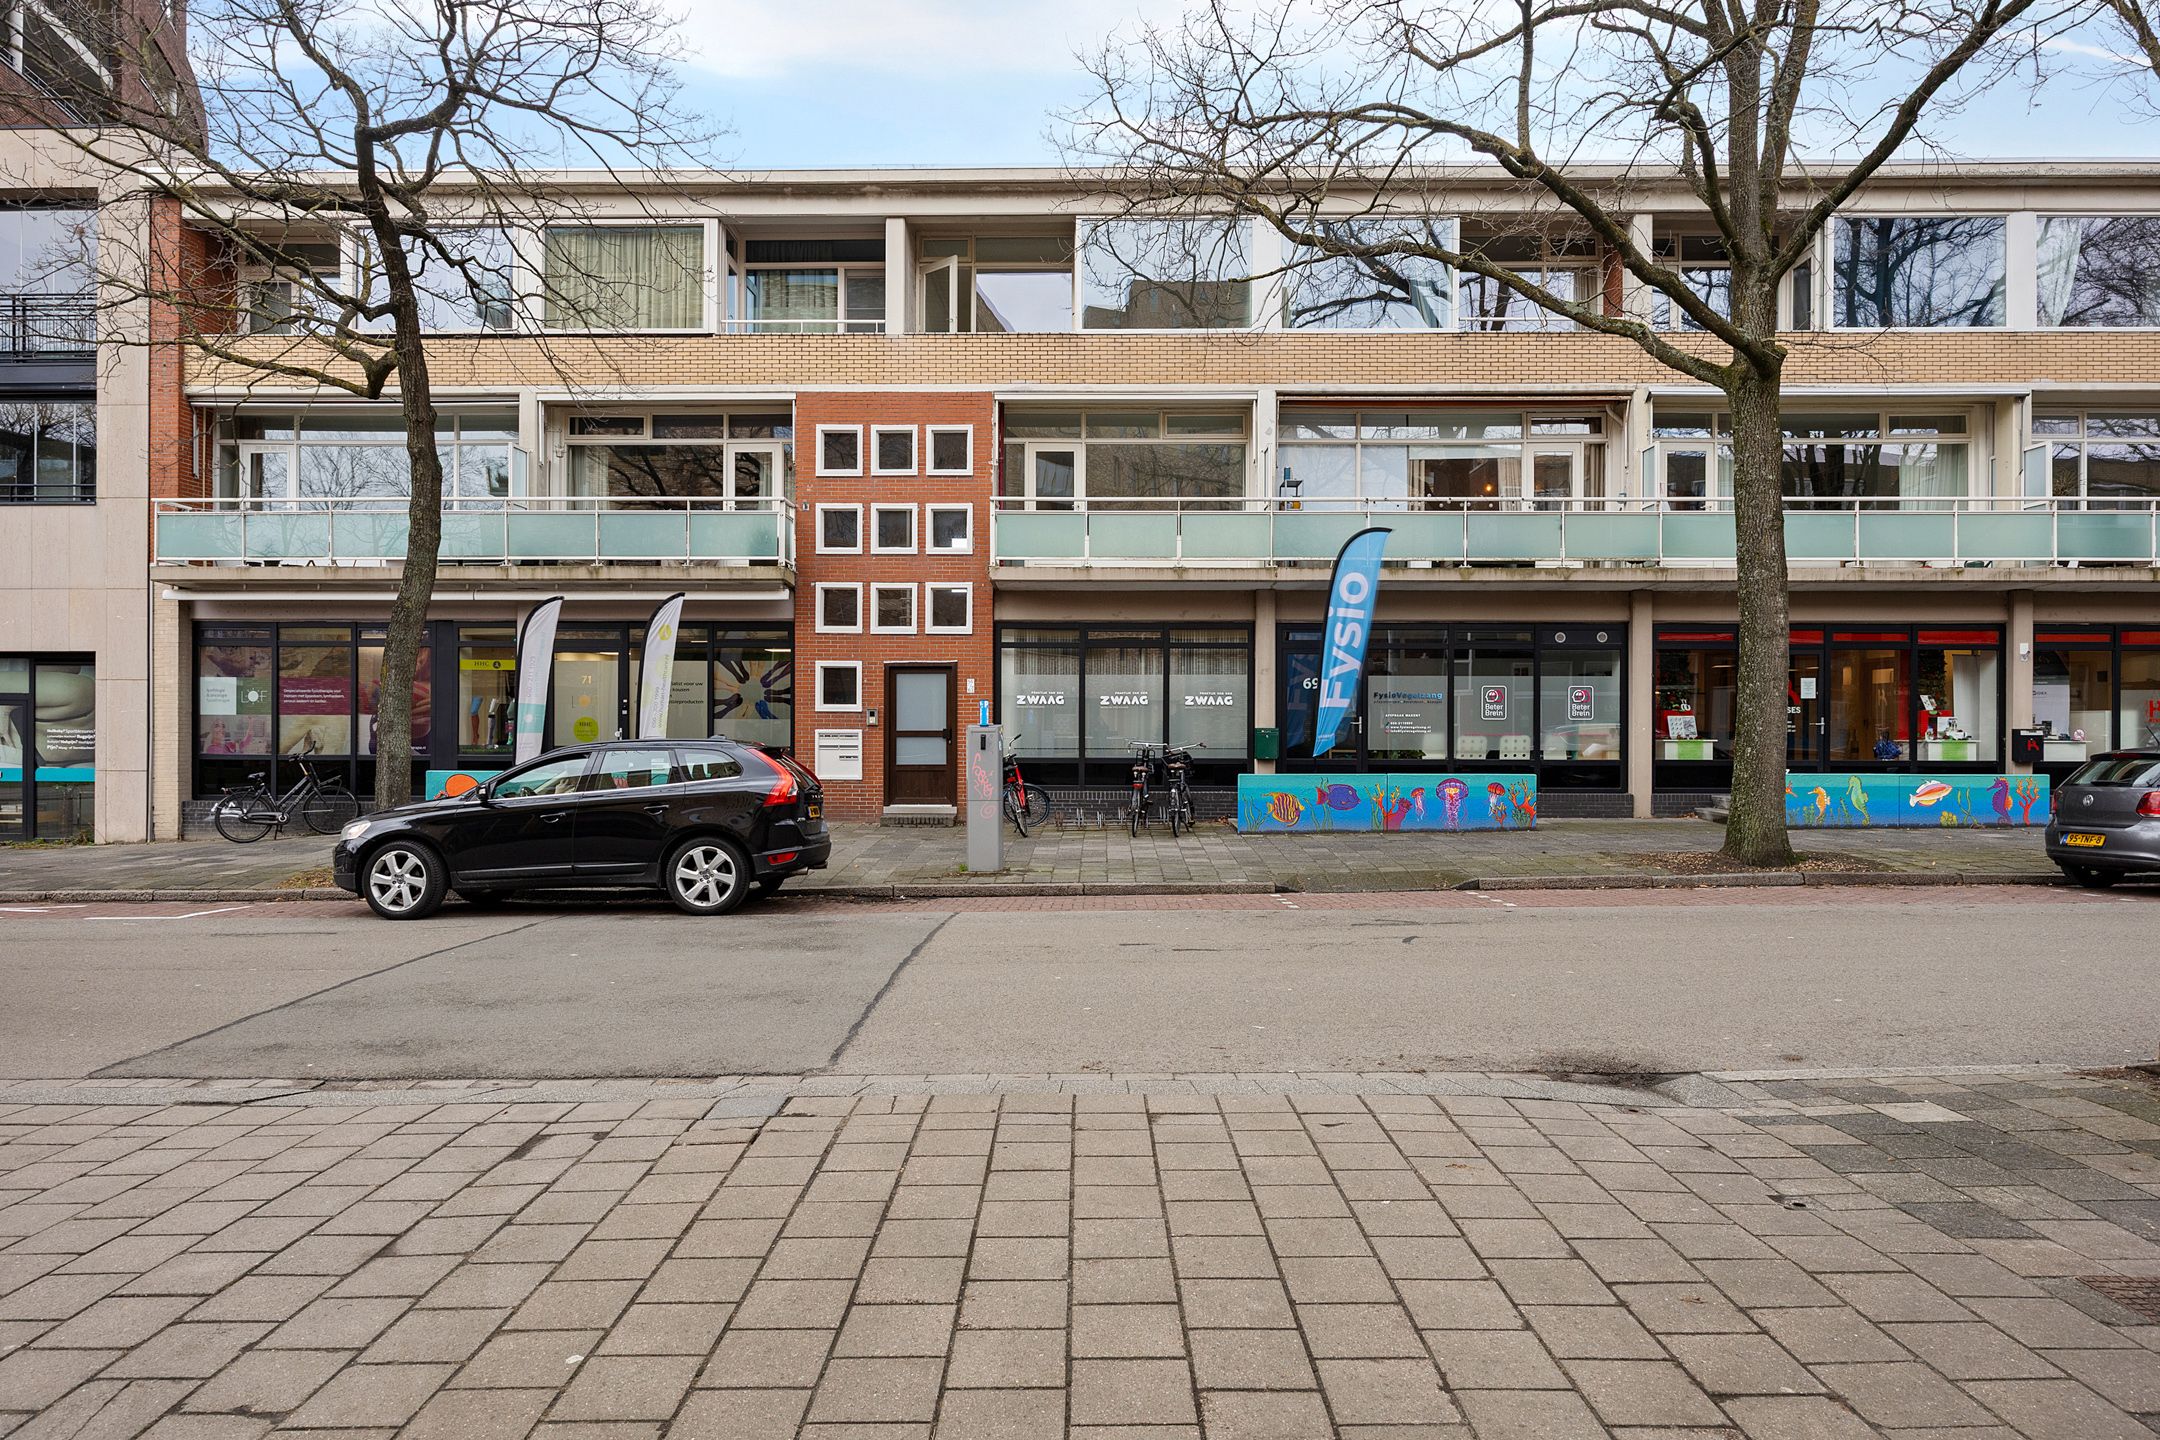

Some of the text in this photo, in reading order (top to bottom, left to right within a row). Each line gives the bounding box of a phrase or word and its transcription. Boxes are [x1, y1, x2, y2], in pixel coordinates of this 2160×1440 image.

[1320, 572, 1368, 708] Fysio
[582, 675, 592, 684] 71
[1303, 677, 1318, 689] 69
[1016, 694, 1064, 705] ZWAAG
[1100, 695, 1148, 705] ZWAAG
[1184, 695, 1233, 706] ZWAAG
[2069, 834, 2102, 844] 95-TNF-8
